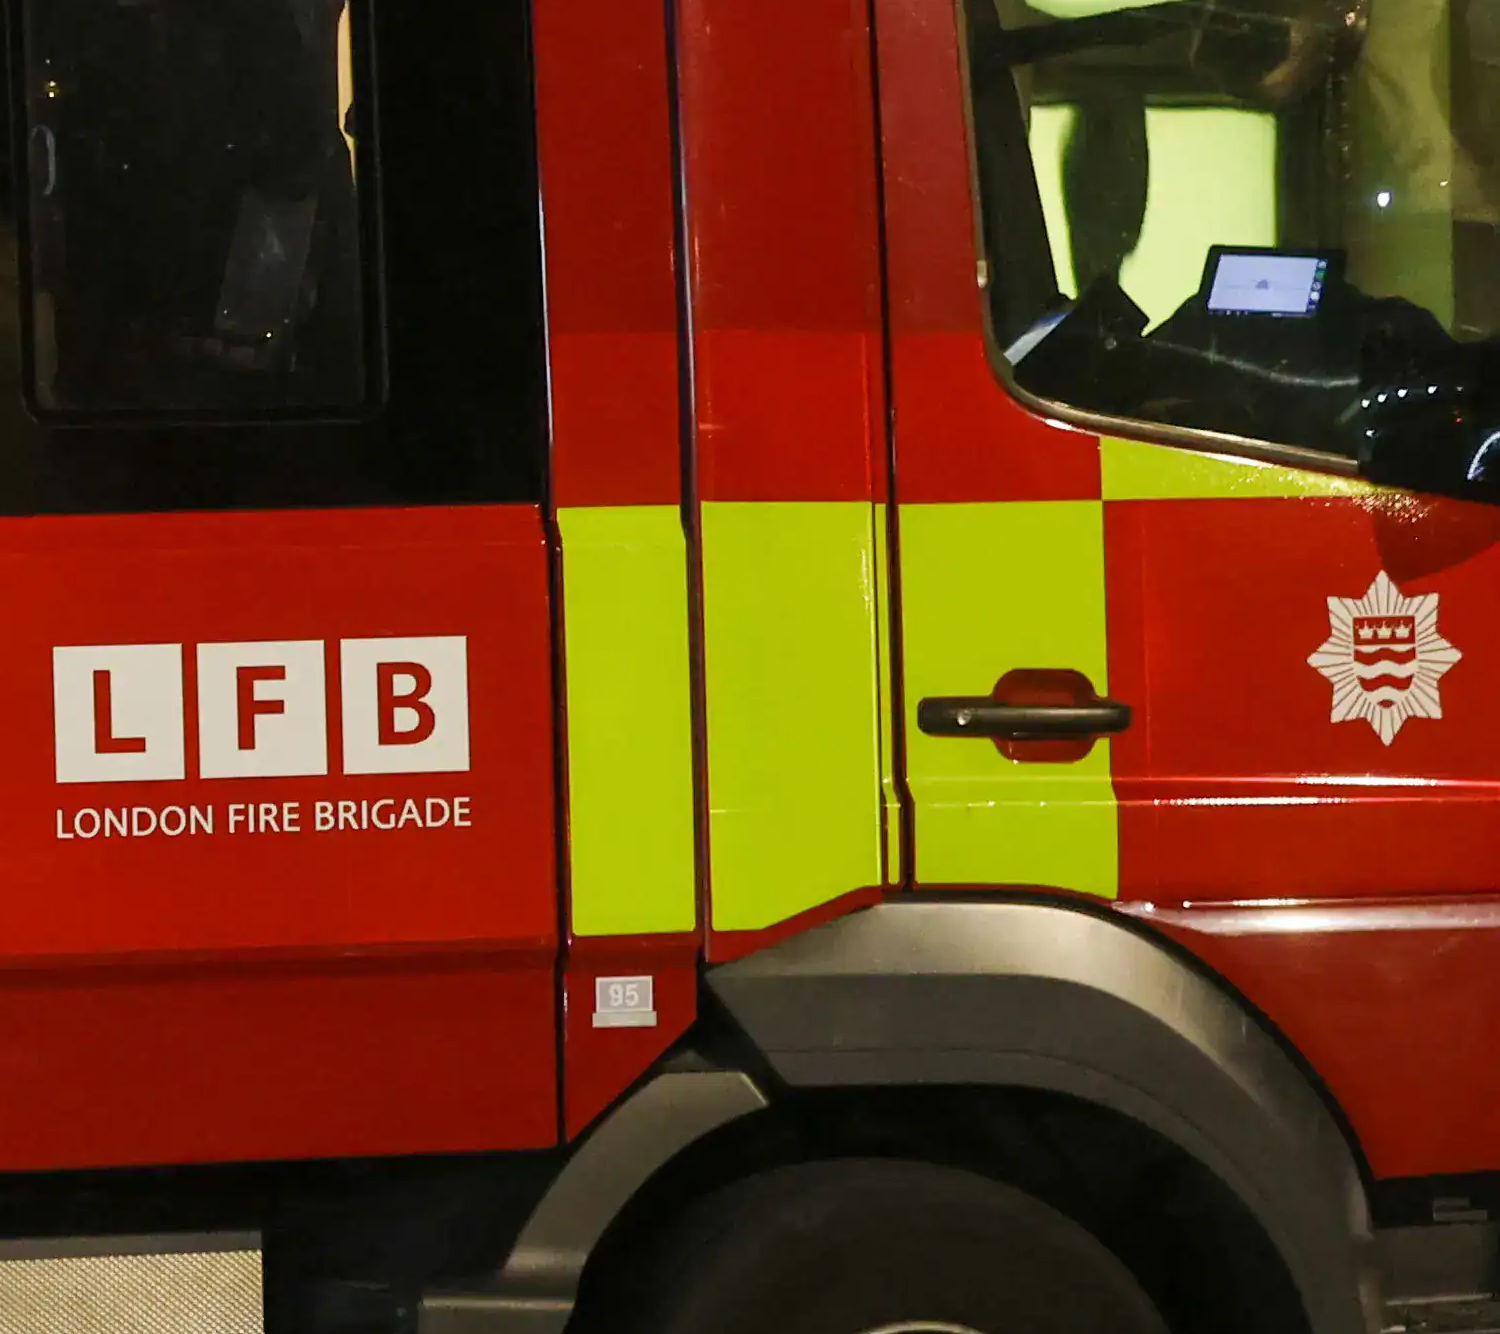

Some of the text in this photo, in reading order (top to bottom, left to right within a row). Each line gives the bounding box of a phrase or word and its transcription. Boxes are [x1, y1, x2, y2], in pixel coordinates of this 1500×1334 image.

[56, 796, 473, 840] LONDON FIRE BRIGADE
[608, 983, 639, 1007] 95
